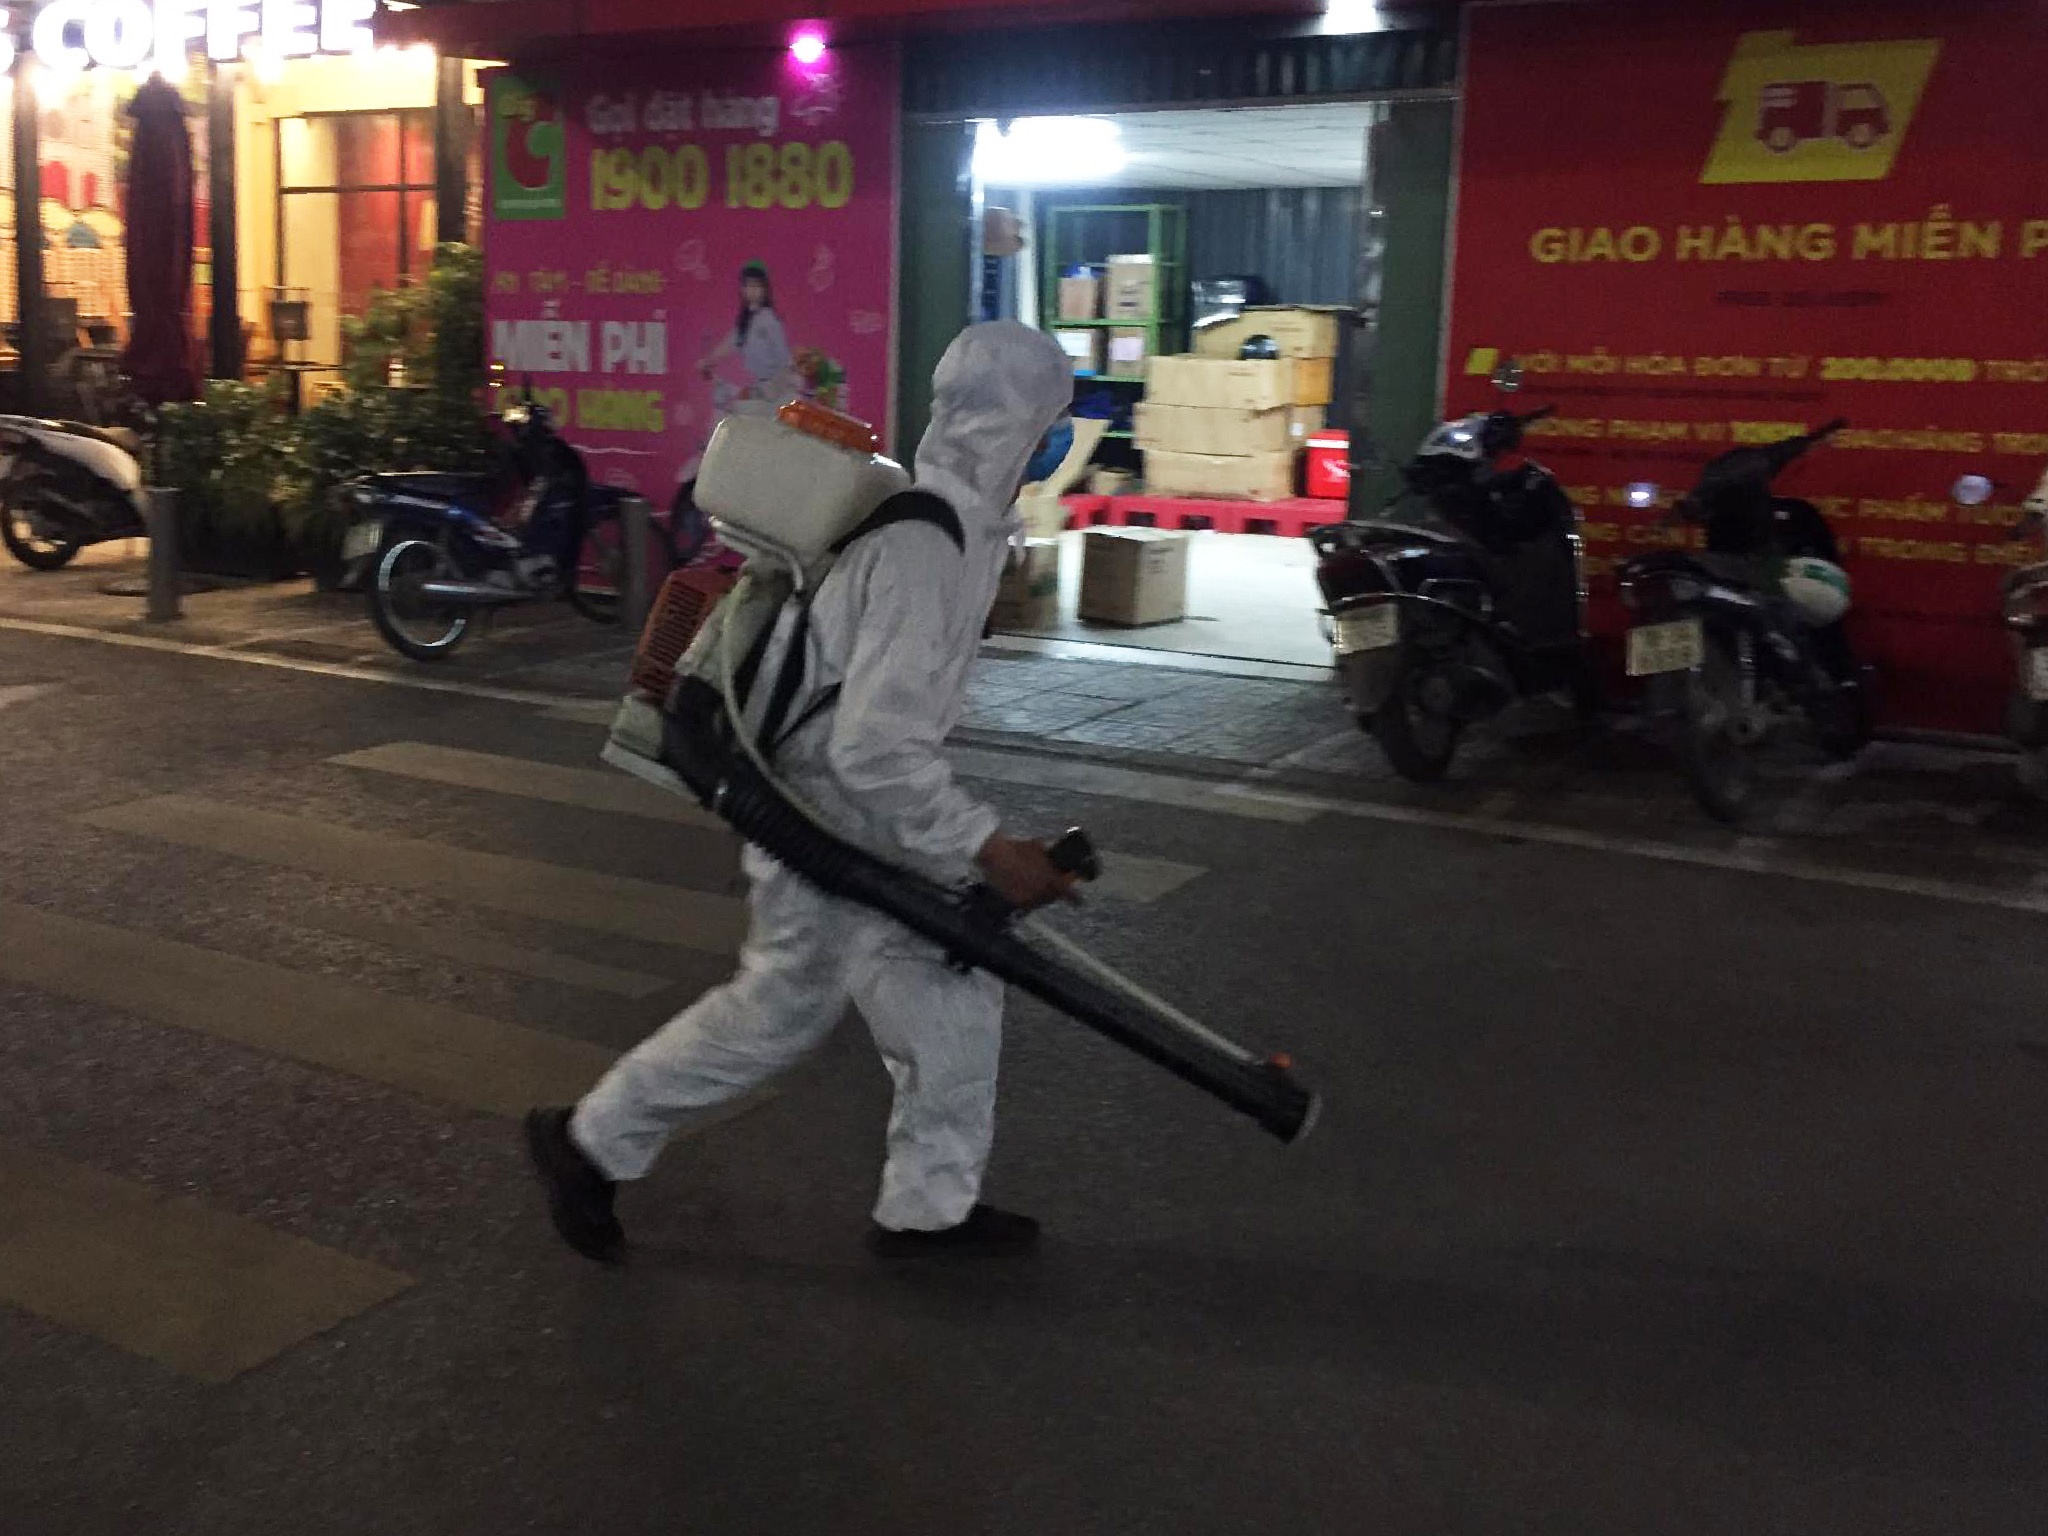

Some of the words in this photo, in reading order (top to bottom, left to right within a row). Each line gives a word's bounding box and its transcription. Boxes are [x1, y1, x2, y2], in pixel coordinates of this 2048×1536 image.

[33, 0, 376, 71] COFFEE
[590, 144, 709, 211] 1900
[725, 140, 854, 210] 1880
[1530, 226, 1661, 263] GIAO
[1676, 214, 1837, 260] HÀNG
[1852, 204, 2001, 260] MIỄN
[492, 300, 590, 372] MIỄN
